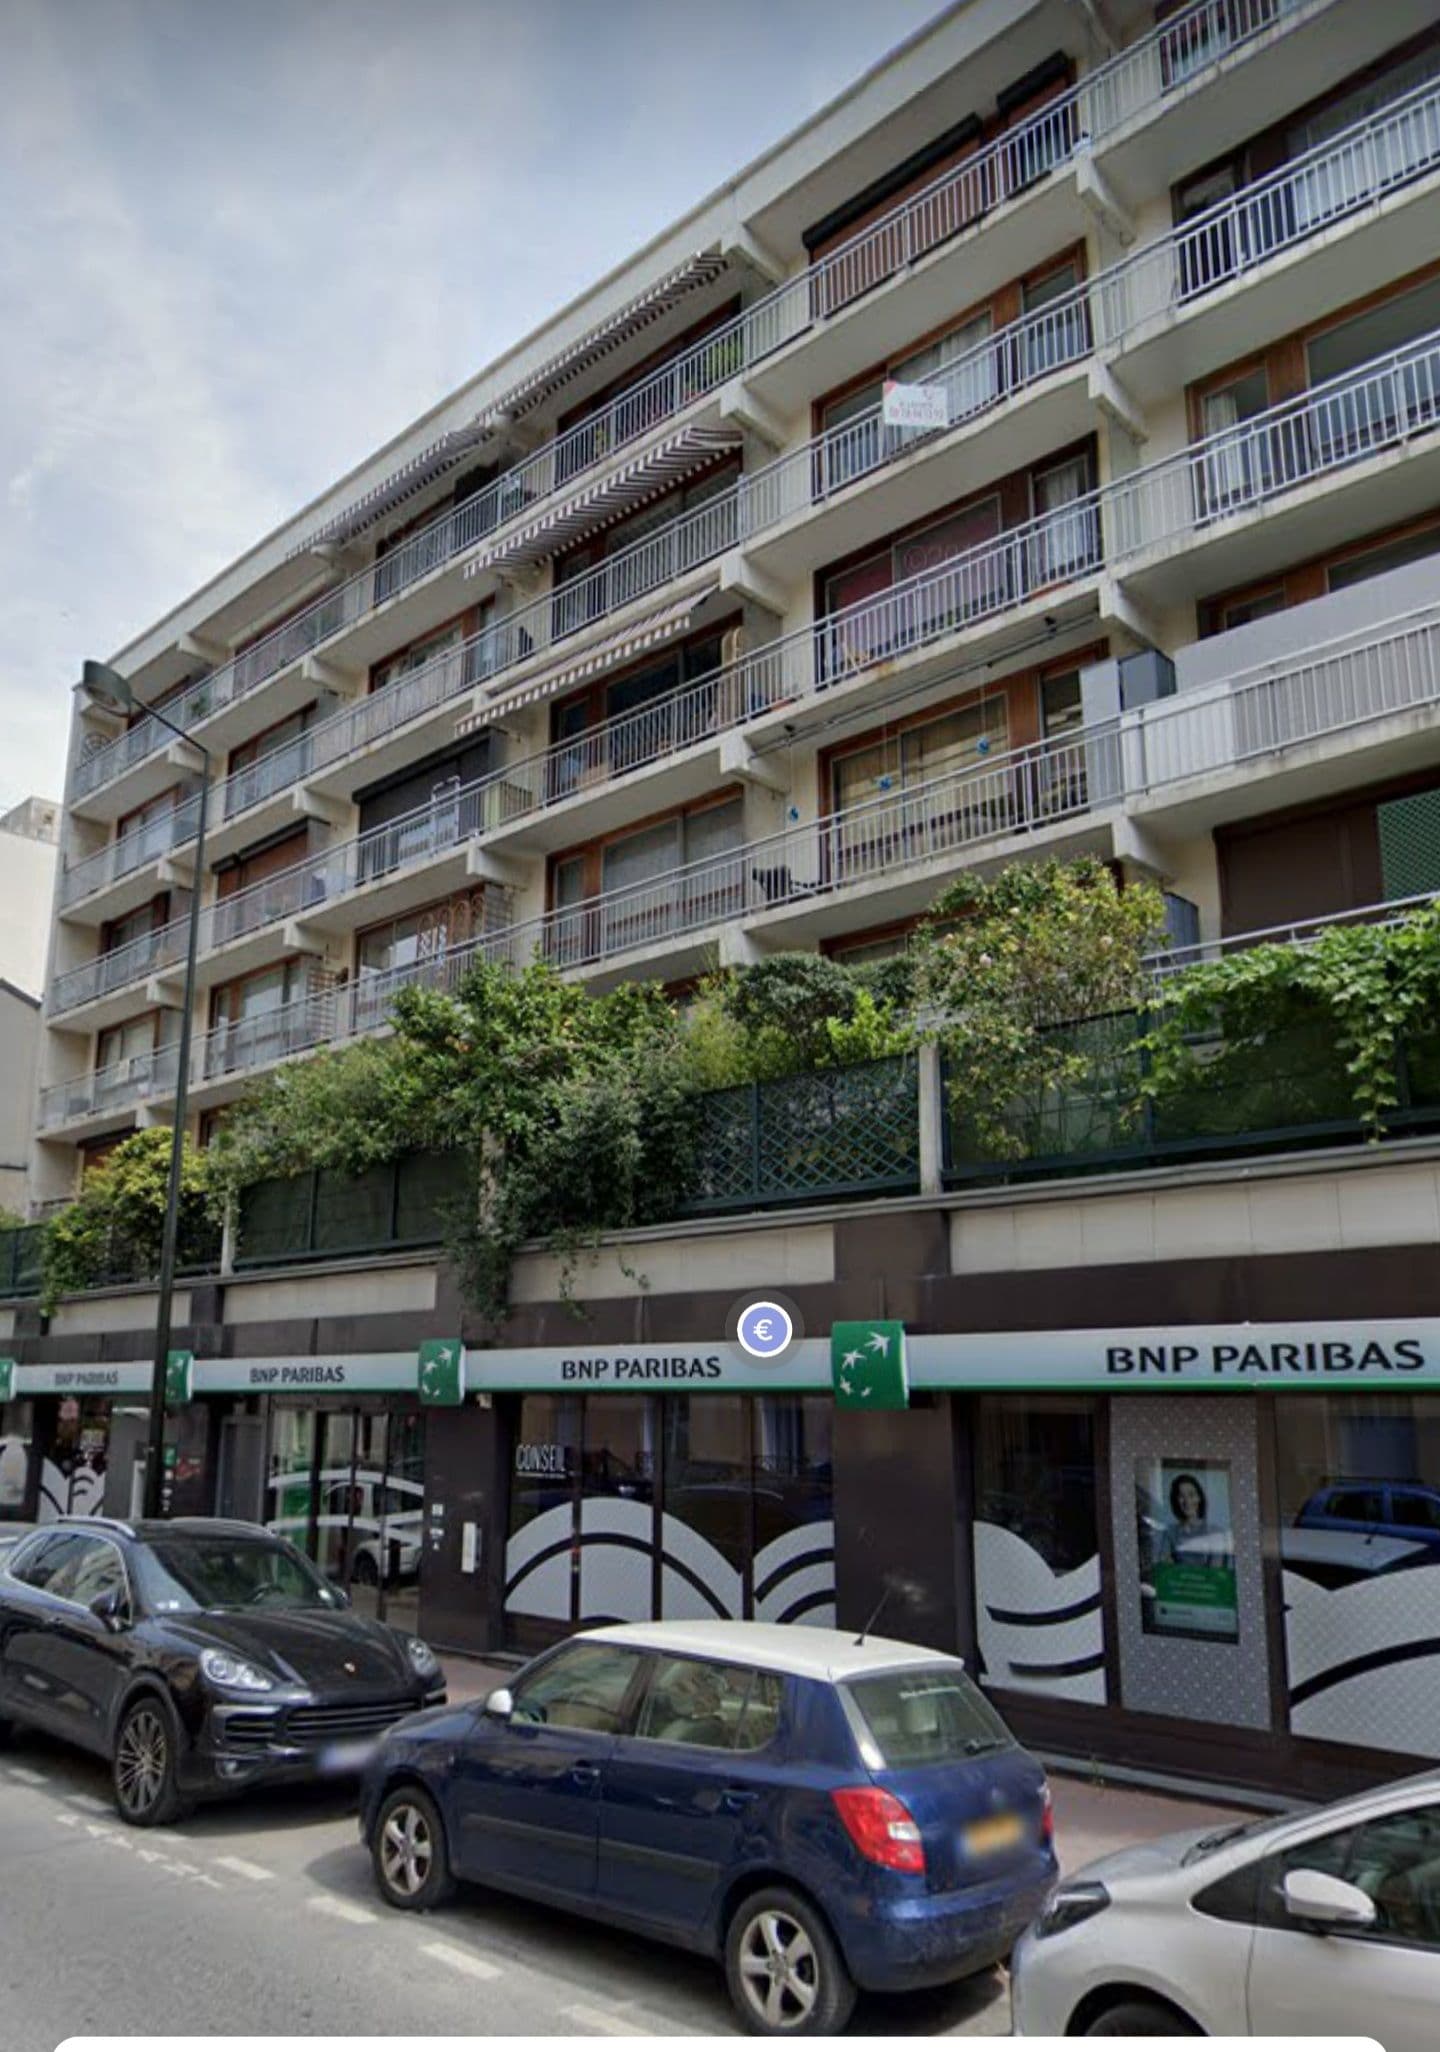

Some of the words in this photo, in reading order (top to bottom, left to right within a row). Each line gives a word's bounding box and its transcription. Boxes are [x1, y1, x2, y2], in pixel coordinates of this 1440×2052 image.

[561, 1359, 608, 1380] BNP
[614, 1356, 722, 1379] PARIBAS
[1106, 1345, 1199, 1374] BNP
[1212, 1339, 1425, 1372] PARIBAS
[249, 1367, 278, 1384] BNP
[280, 1365, 345, 1383] PARIBAS
[516, 1443, 567, 1472] CONSEIL
